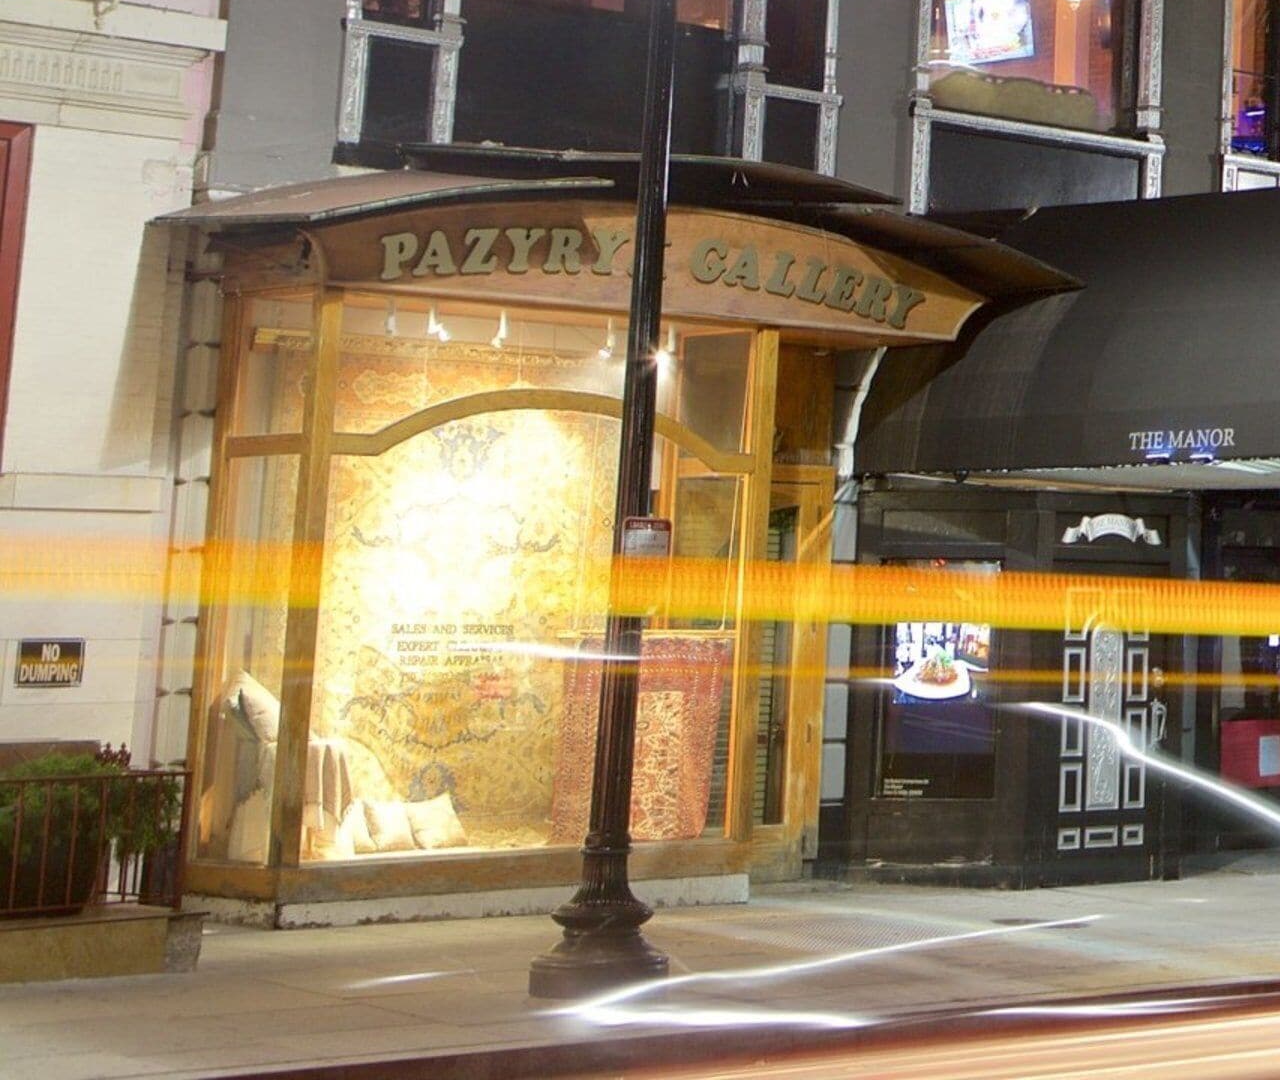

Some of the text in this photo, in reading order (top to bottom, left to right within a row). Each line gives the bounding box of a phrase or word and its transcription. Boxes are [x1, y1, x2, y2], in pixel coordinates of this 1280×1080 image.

[379, 227, 925, 329] PAZYRY GALLERY
[1129, 427, 1235, 451] THE MANOR
[391, 623, 514, 636] SALES AND SERVICES
[41, 643, 60, 662] NO
[397, 641, 439, 652] EXPERT
[19, 663, 78, 683] DUMPING
